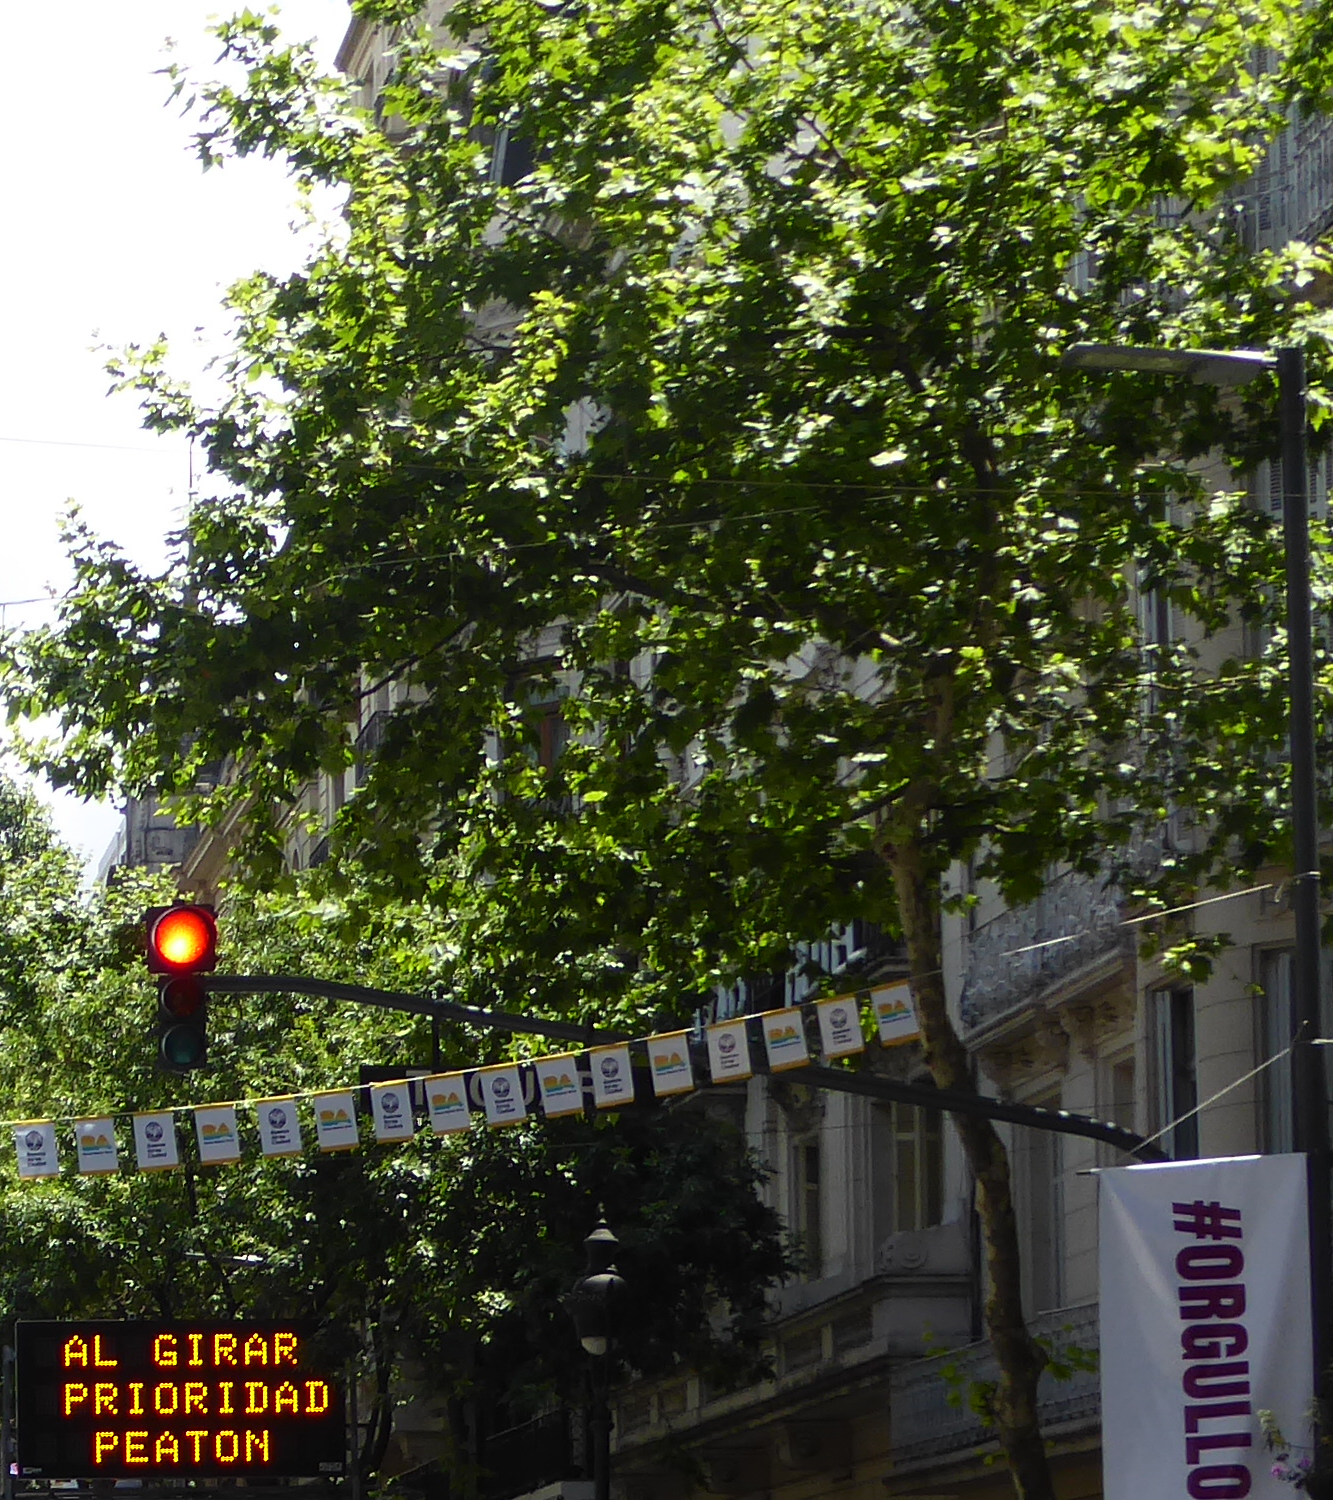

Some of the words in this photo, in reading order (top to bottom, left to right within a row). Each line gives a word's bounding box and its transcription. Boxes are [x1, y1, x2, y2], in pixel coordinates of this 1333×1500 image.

[64, 1334, 118, 1367] AL
[154, 1332, 299, 1366] GIRAR
[64, 1380, 329, 1415] PRIORIDAD
[95, 1429, 270, 1463] PEATON
